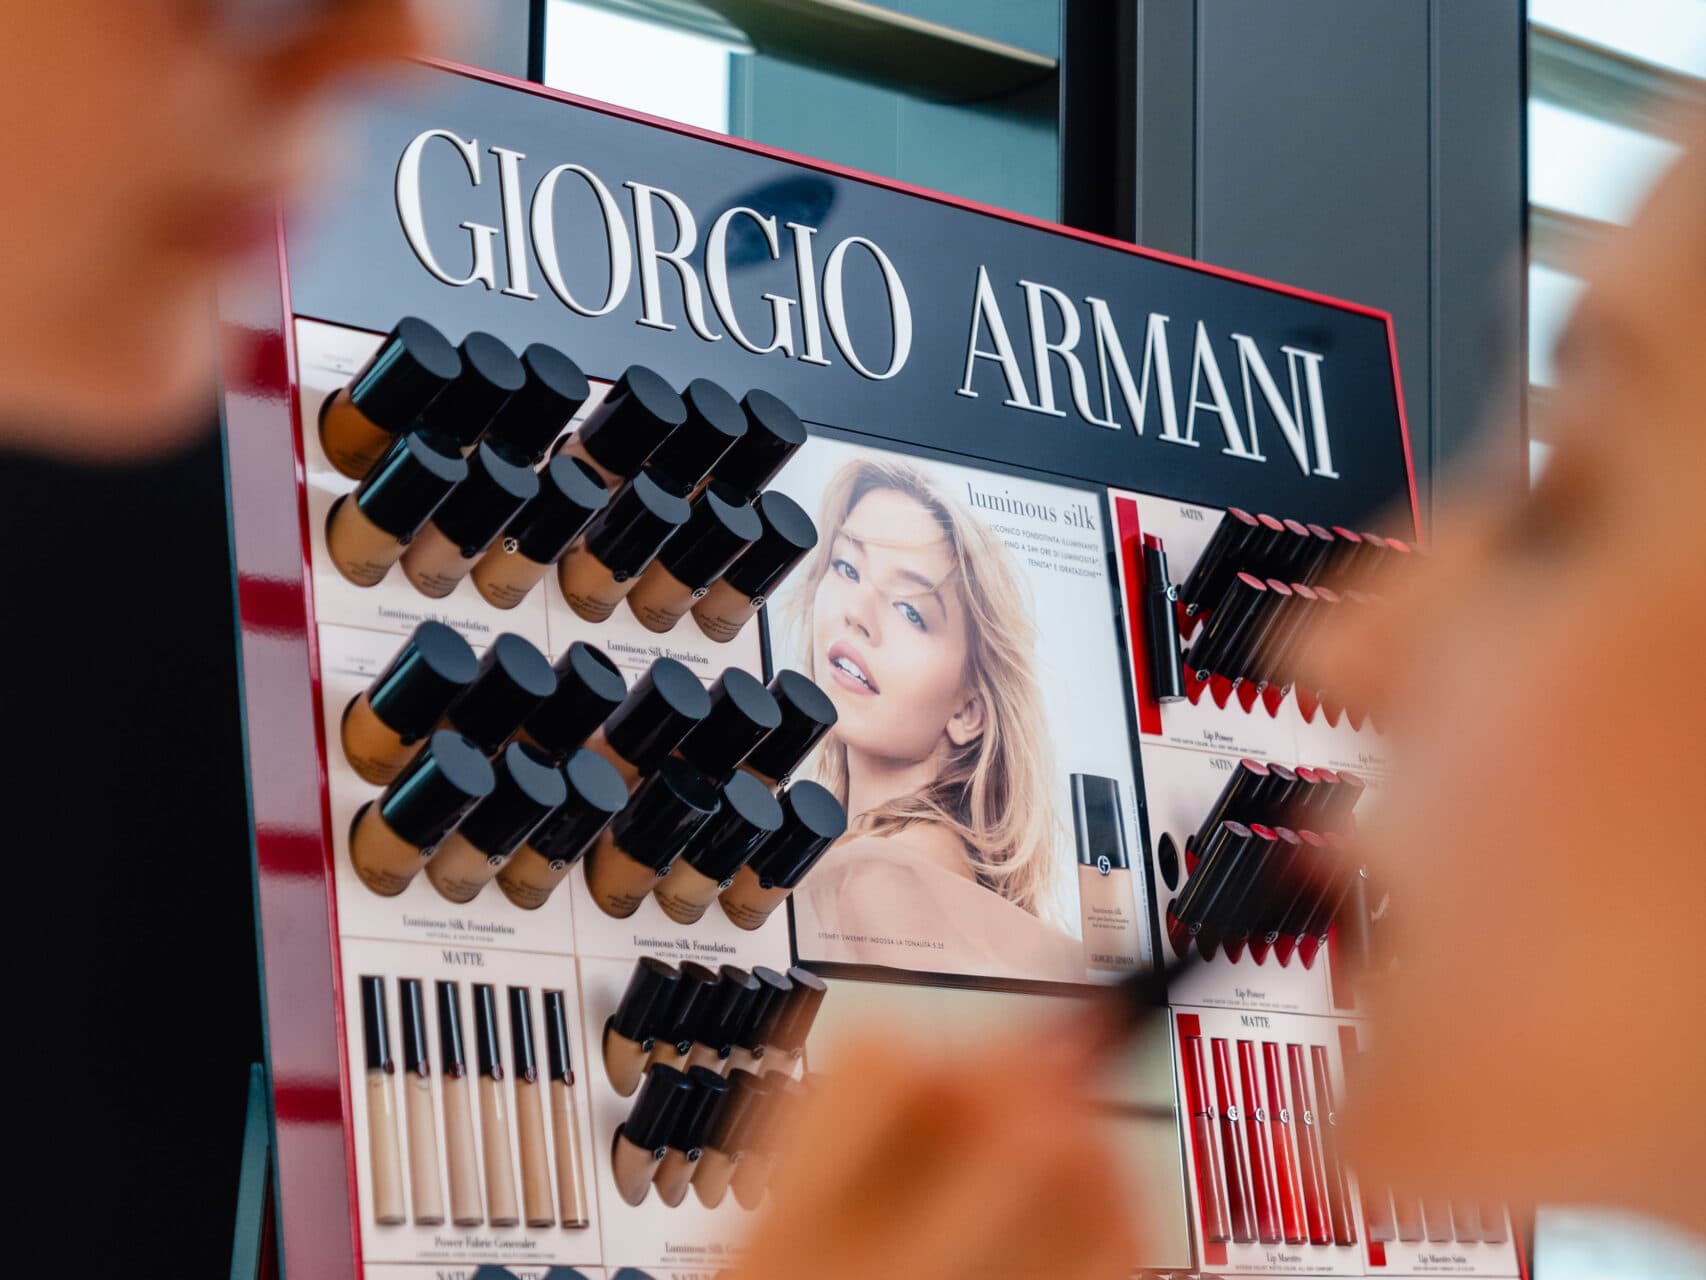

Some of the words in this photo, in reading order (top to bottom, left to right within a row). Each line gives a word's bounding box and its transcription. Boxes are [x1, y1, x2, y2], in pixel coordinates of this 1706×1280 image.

[395, 128, 913, 382] GIORGIO
[957, 264, 1340, 480] ARMANI
[967, 482, 1057, 523] luminous
[1063, 503, 1096, 531] silk
[1179, 507, 1204, 521] SATIN
[1004, 540, 1019, 550] FINO
[378, 605, 421, 621] Luminous
[442, 615, 490, 633] Foundation
[607, 639, 647, 656] Luminous
[665, 649, 709, 665] Foundation
[1203, 729, 1213, 742] Lip
[1214, 730, 1233, 743] Power
[1209, 758, 1233, 771] SATIN
[402, 914, 447, 929] Luminous
[449, 917, 464, 931] Silk
[467, 919, 515, 935] Foundation
[633, 935, 674, 949] Luminous
[675, 938, 690, 950] Silk
[693, 939, 737, 954] Foundation
[440, 950, 485, 967] MATTE
[1235, 987, 1246, 999] Lip
[1247, 988, 1265, 999] Power
[1240, 1014, 1271, 1030] MATTE
[434, 1236, 463, 1249] Power
[465, 1236, 492, 1249] Fabric
[494, 1237, 536, 1249] Concealer
[665, 1241, 707, 1254] Luminous
[1266, 1252, 1278, 1265] Lip
[1279, 1253, 1302, 1263] Maestro
